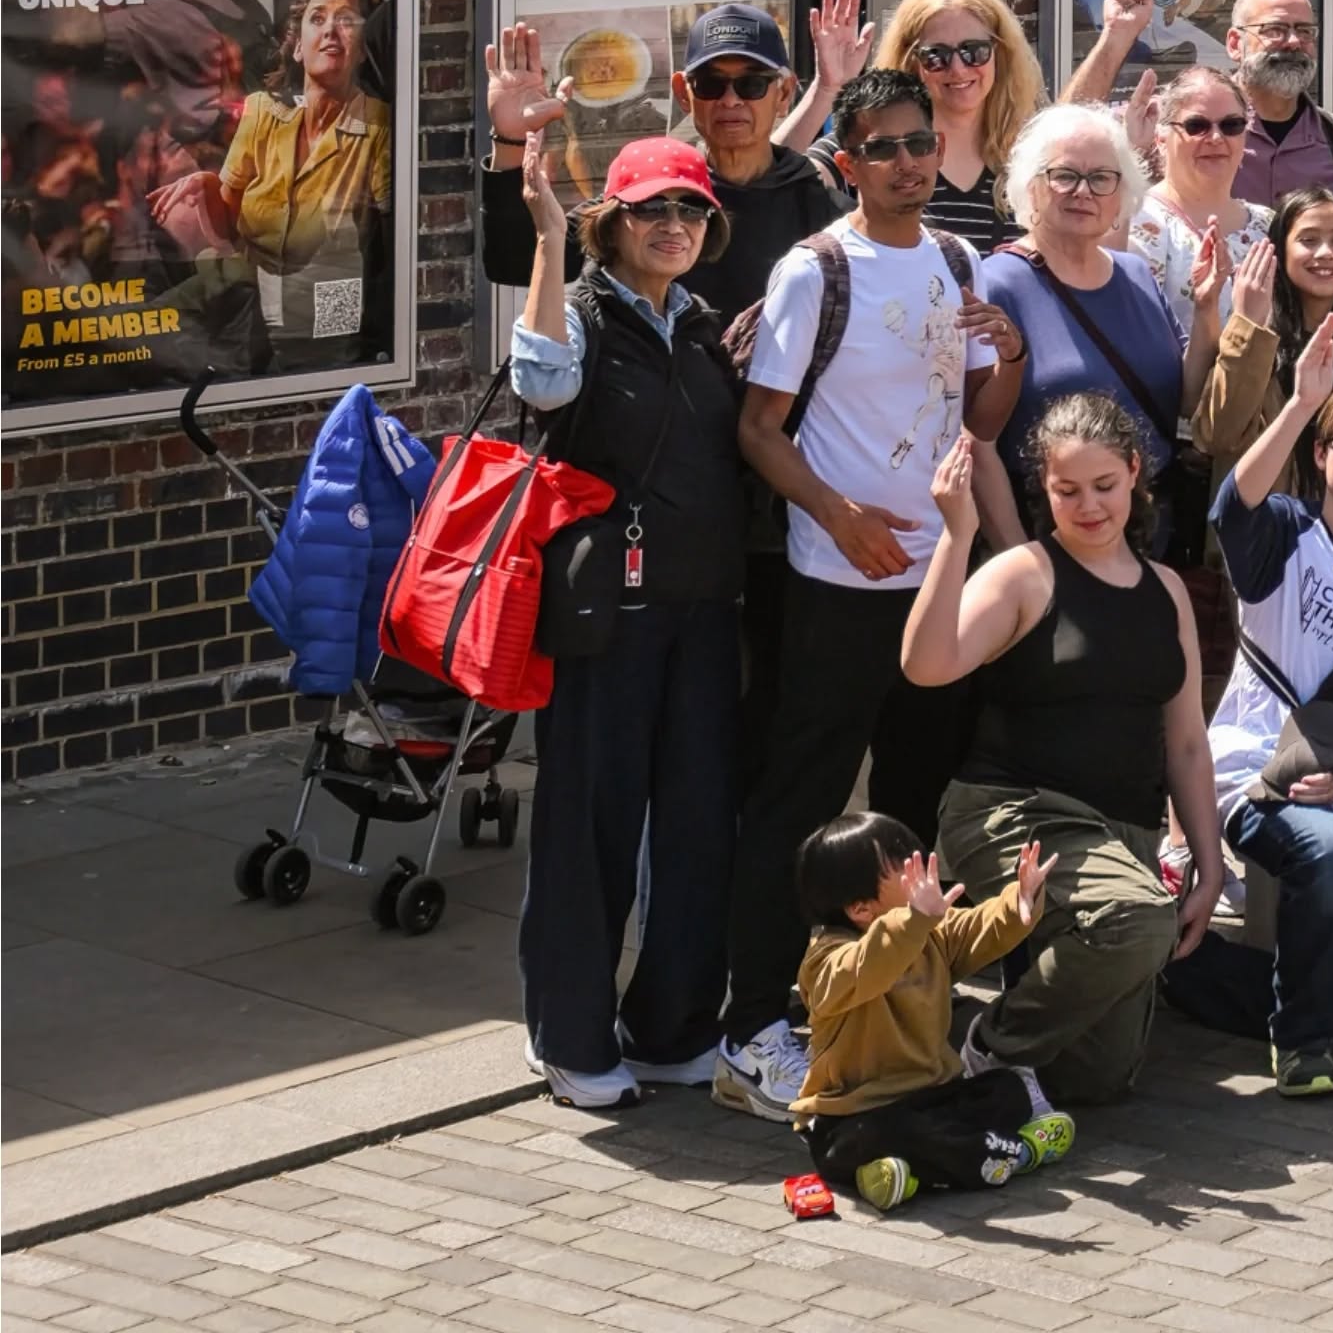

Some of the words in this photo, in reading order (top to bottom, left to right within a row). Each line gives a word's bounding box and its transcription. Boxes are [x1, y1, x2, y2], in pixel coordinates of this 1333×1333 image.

[22, 278, 145, 315] BECOME
[19, 323, 44, 348] A
[52, 308, 181, 345] MEMBER
[17, 357, 59, 372] From
[63, 353, 85, 367] £5
[89, 355, 98, 365] a
[103, 345, 152, 365] month
